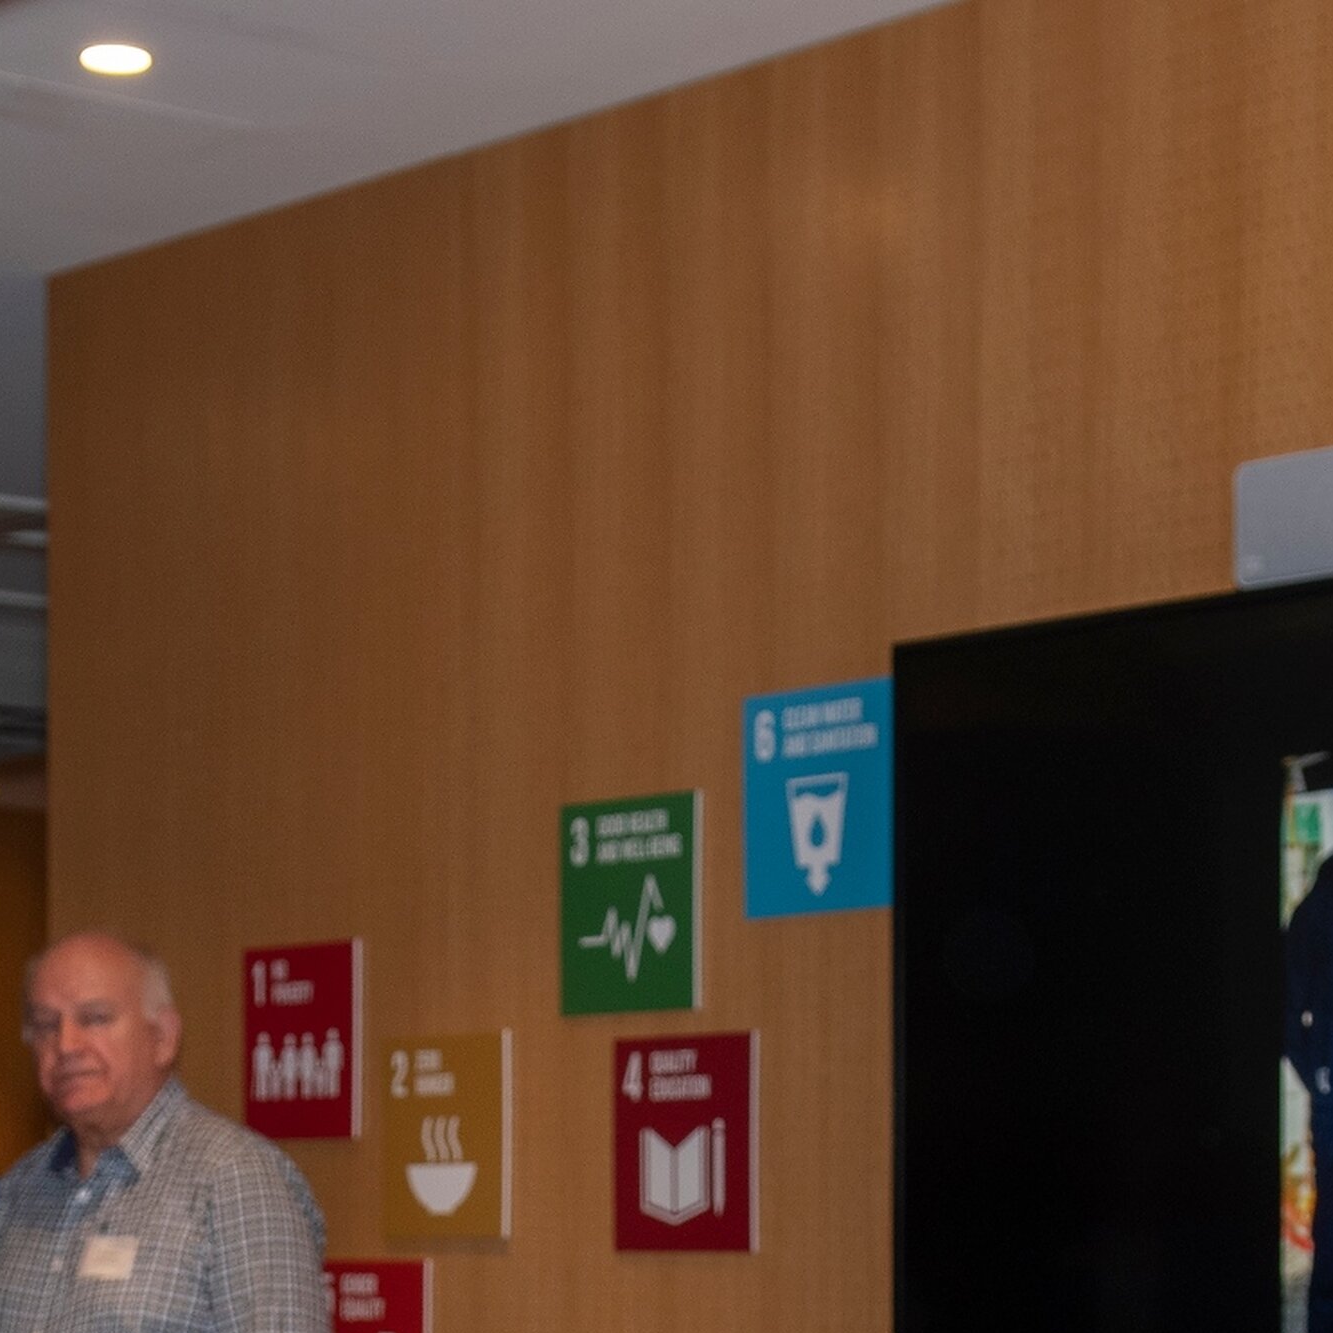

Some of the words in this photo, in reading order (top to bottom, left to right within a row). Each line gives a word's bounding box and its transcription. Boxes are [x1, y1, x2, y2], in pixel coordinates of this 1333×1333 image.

[754, 709, 777, 764] 6
[570, 816, 589, 868] 3
[251, 960, 267, 1008] 1
[390, 1049, 409, 1099] 2
[621, 1050, 644, 1103] 4
